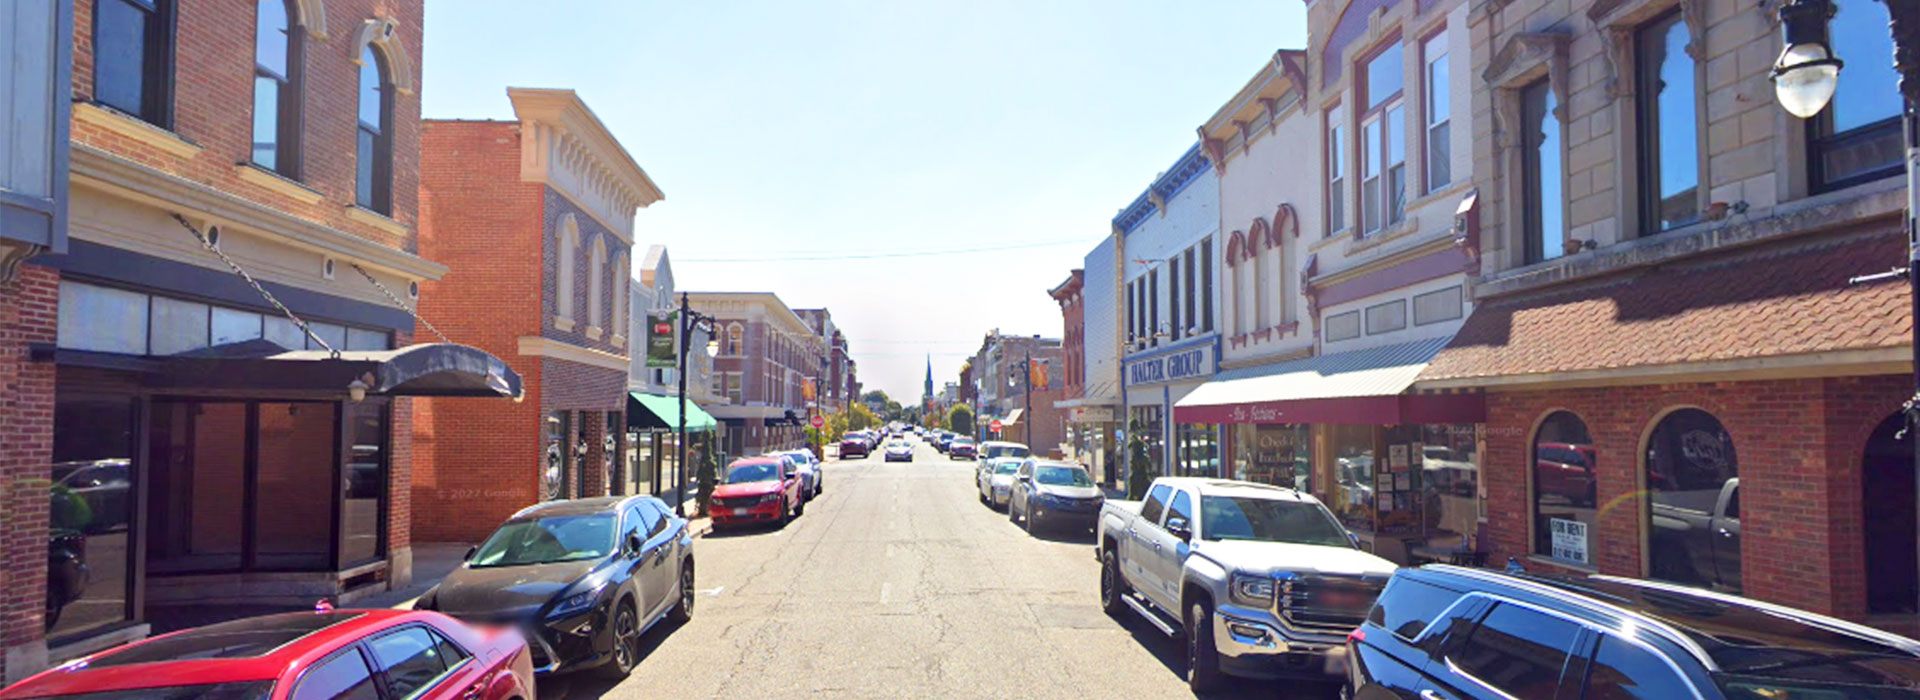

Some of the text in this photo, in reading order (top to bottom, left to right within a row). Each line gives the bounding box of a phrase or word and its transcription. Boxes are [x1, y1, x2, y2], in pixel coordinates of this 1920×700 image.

[1131, 349, 1204, 385] HALTER GROUP
[1552, 519, 1585, 537] FOR RENT
